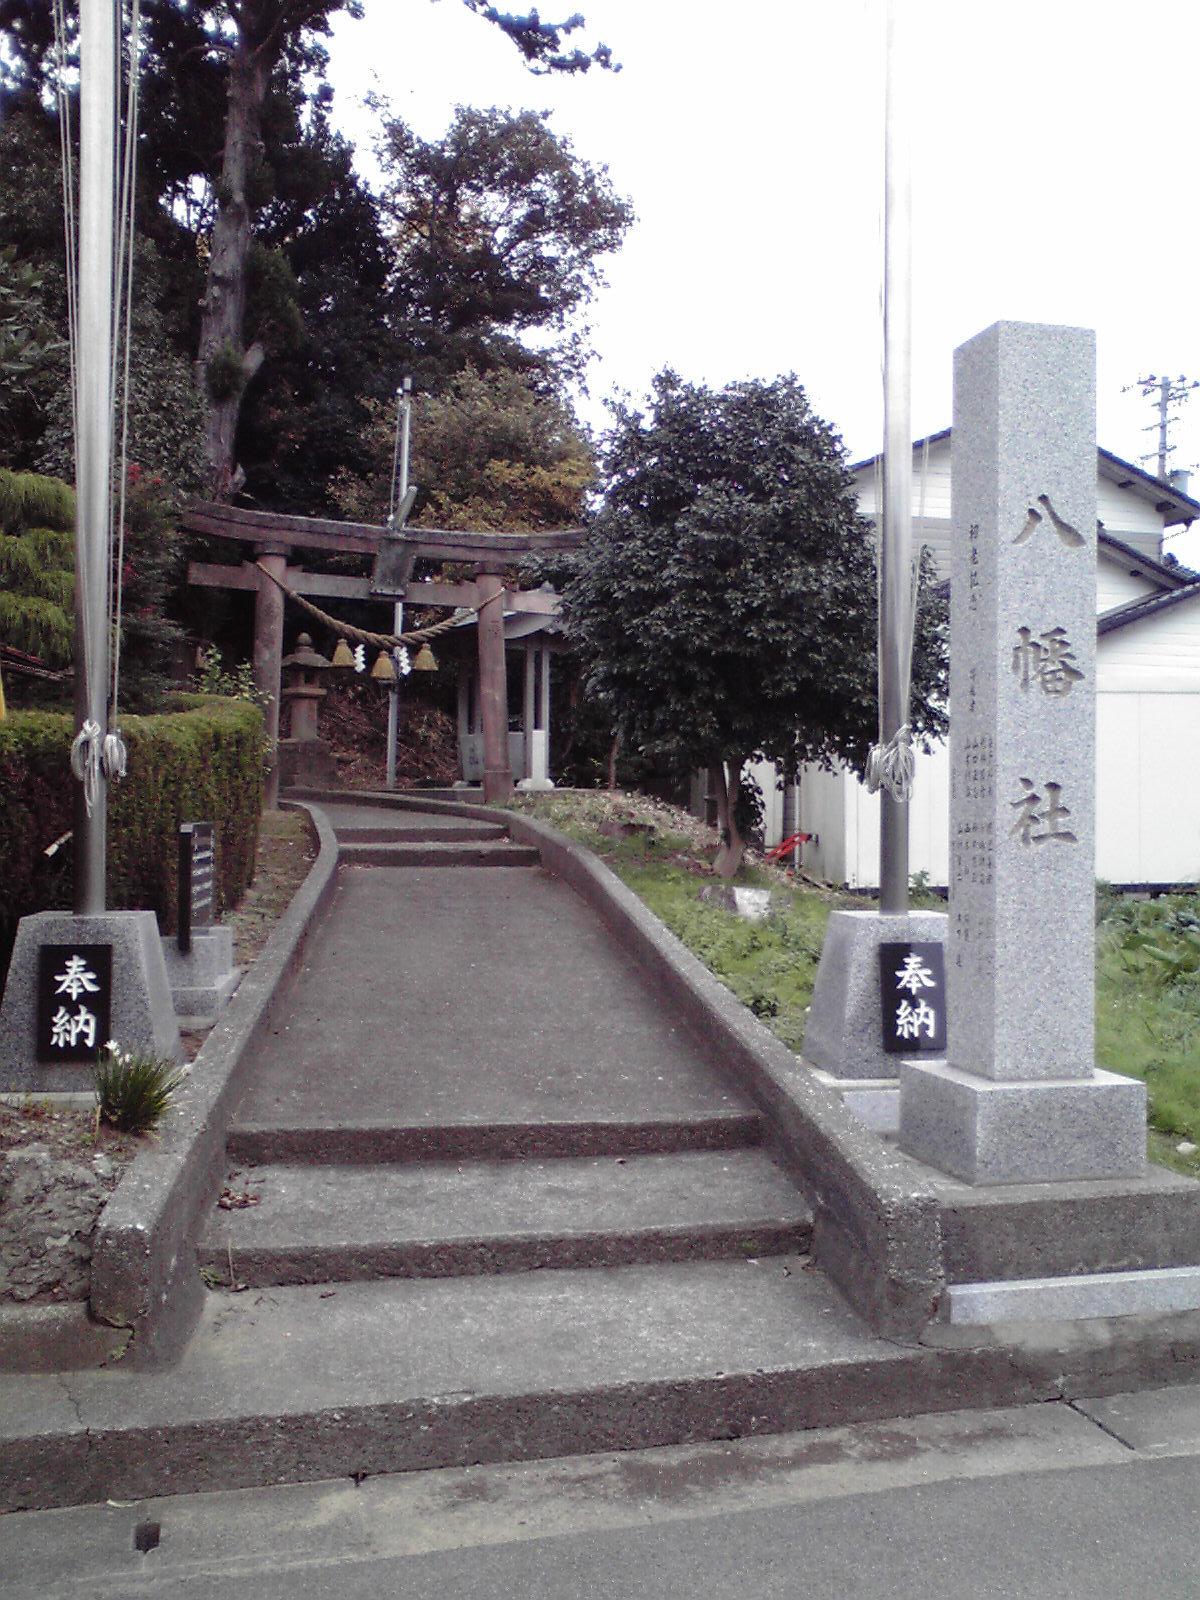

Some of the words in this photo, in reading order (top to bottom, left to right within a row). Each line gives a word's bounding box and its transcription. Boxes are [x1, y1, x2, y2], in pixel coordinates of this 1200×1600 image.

[1009, 494, 1087, 850] 八幡社
[50, 954, 101, 1049] 奉納
[895, 952, 937, 1040] 奉納
